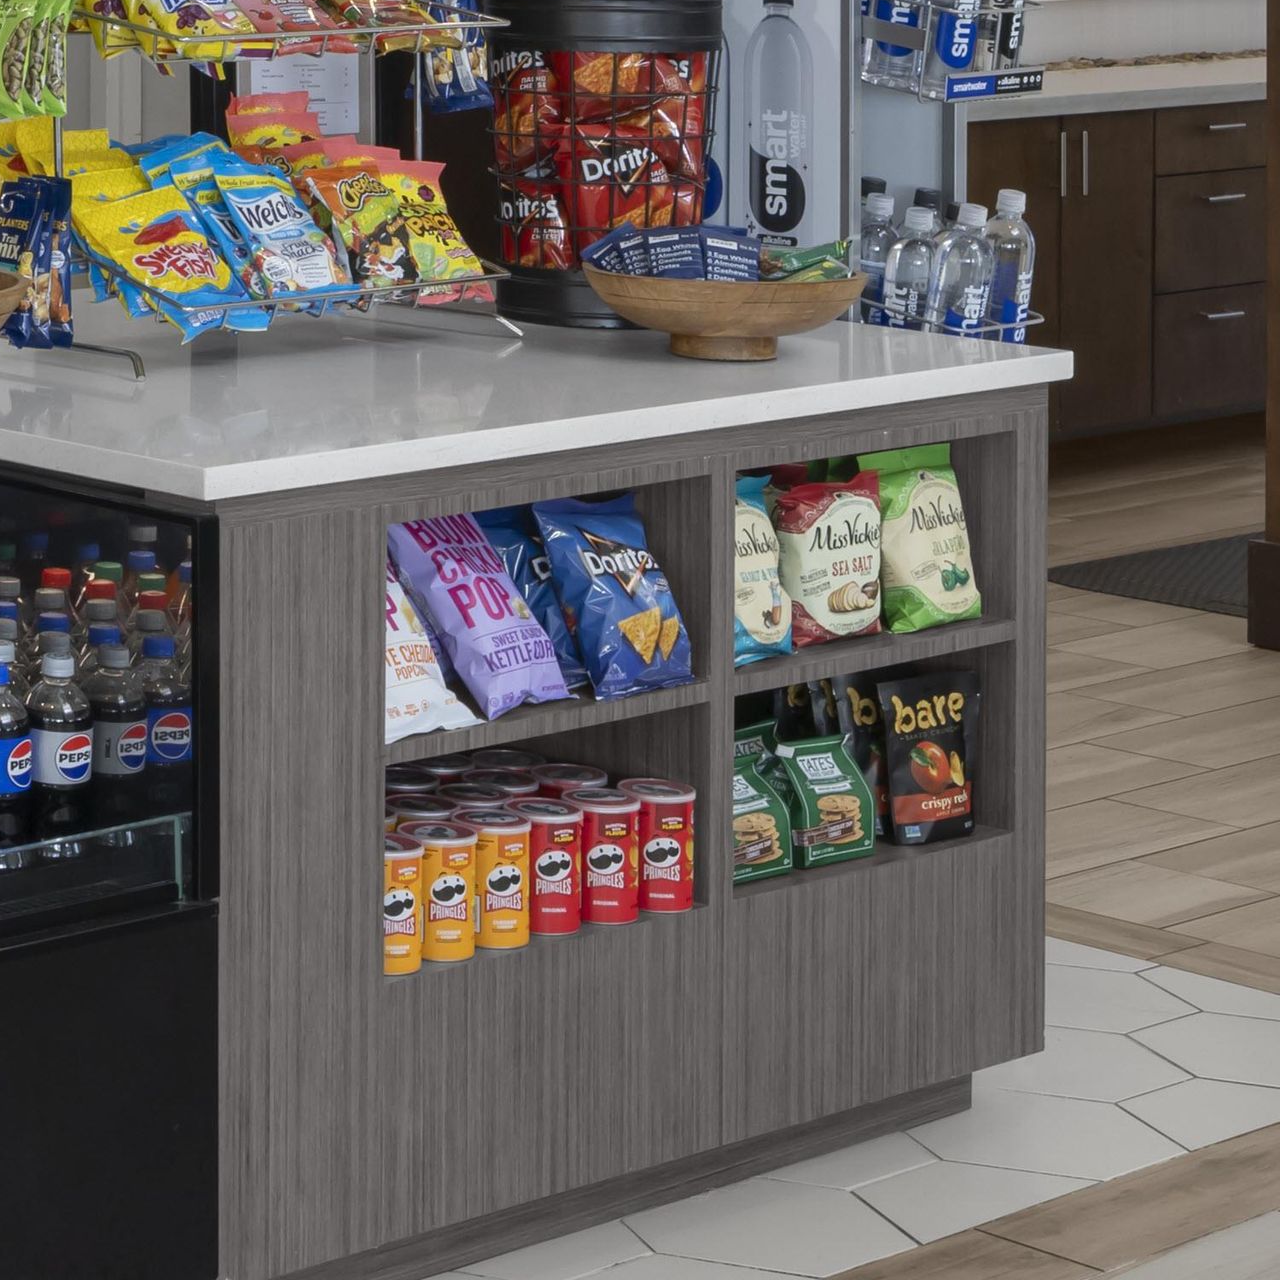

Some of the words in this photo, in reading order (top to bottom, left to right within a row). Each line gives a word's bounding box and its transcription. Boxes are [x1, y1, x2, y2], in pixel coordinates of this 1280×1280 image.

[491, 51, 544, 78] oritos
[953, 81, 988, 93] smartwater
[580, 145, 658, 182] Dorito
[762, 109, 787, 216] smart
[789, 111, 800, 159] water
[1, 232, 18, 245] Trail
[657, 250, 692, 259] Almonds
[713, 252, 729, 261] Egg
[658, 263, 681, 272] Dates
[713, 260, 749, 270] Almonds
[713, 274, 736, 282] Dates
[809, 524, 848, 552] Miss
[843, 512, 881, 549] Vickie'
[583, 546, 659, 575] Dorito
[831, 558, 850, 577] SEA
[852, 554, 874, 573] SALT
[447, 576, 514, 629] POP
[491, 630, 520, 648] SWEET
[891, 691, 965, 734] bare
[59, 751, 90, 763] PEPS
[735, 740, 764, 757] ATE'S
[10, 757, 32, 770] PEP
[798, 755, 835, 773] TATE'S
[921, 795, 952, 811] crispy
[587, 871, 624, 889] PRINGLES
[643, 863, 680, 882] PRINGLES
[535, 877, 572, 896] PRINGLES
[486, 892, 522, 911] PRINGLES
[430, 902, 467, 920] PRINGLES
